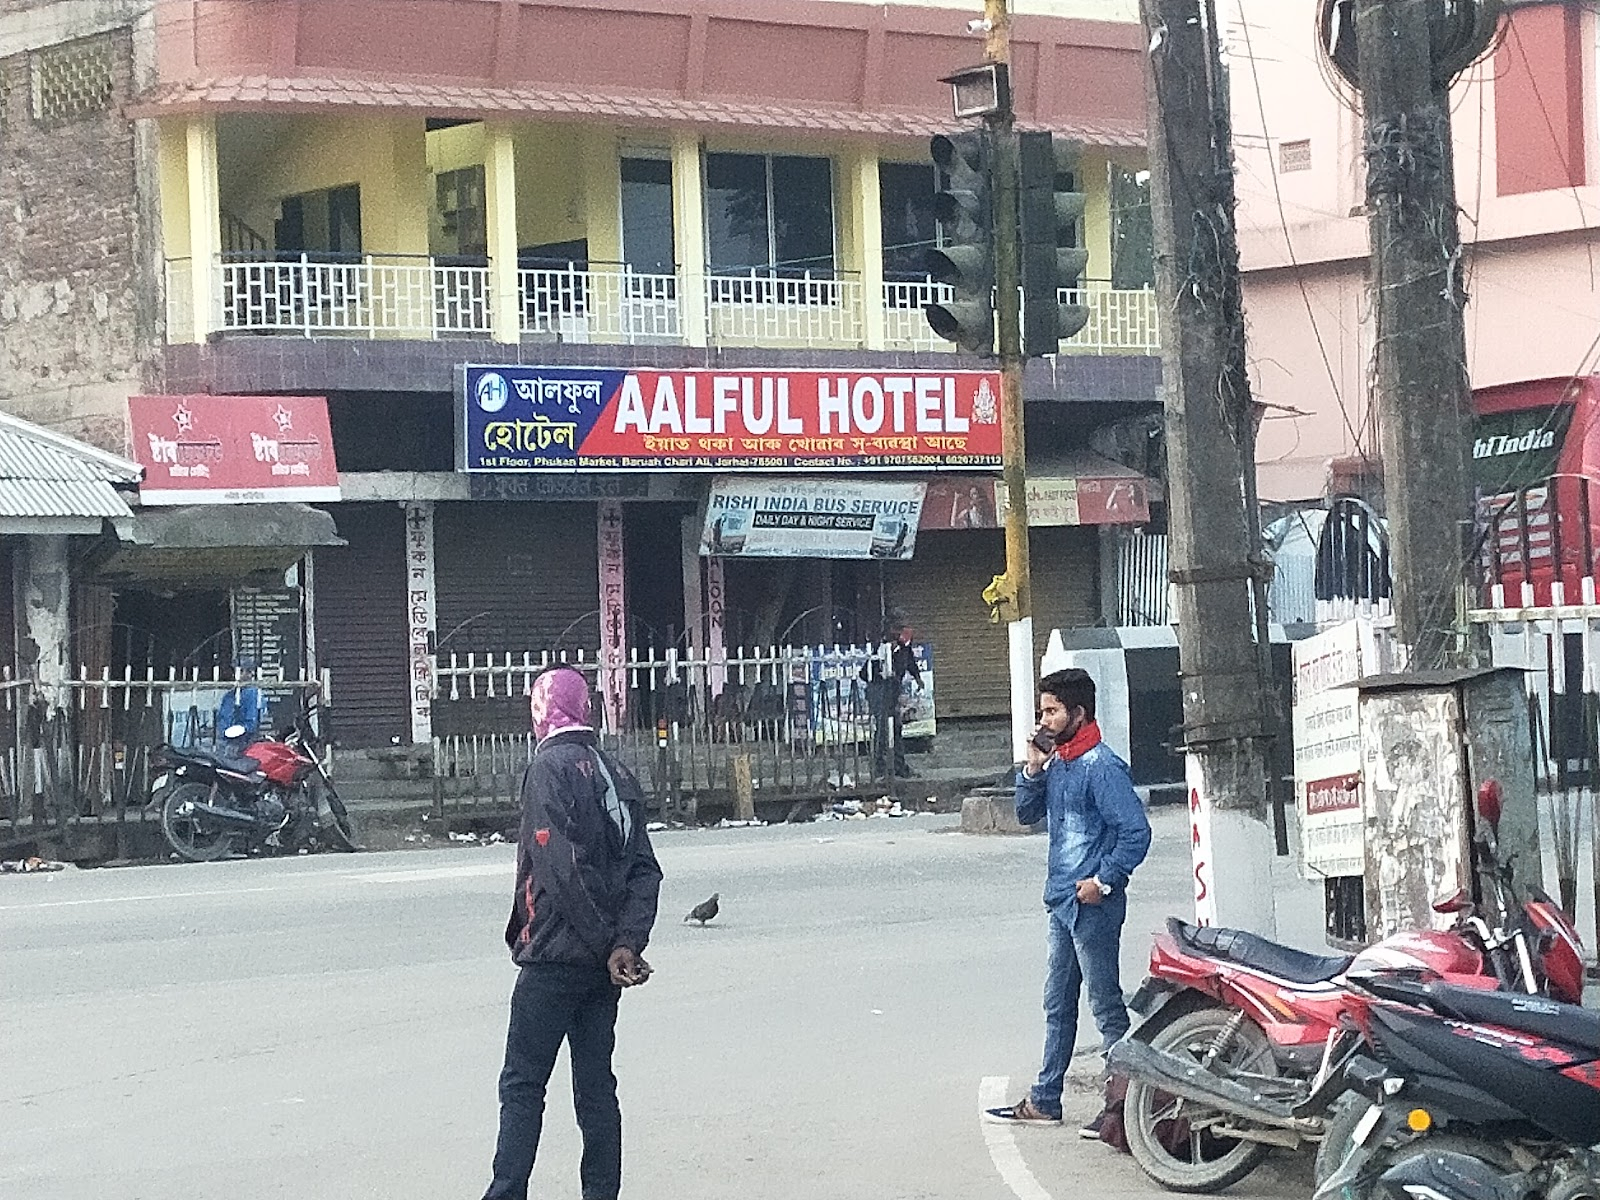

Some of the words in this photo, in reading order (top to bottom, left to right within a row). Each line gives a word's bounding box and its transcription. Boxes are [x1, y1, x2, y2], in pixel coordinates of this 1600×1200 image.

[512, 376, 602, 413] আলফুল
[613, 375, 803, 434] AALFUL
[818, 377, 969, 433] HOTEL
[484, 413, 577, 453] হোটেল
[923, 435, 968, 452] আছে
[1501, 429, 1555, 456] India
[480, 457, 496, 467] 1st
[499, 457, 532, 468] Floor,
[534, 457, 576, 467] Phukan
[578, 457, 619, 468] Market,
[622, 457, 662, 467] Baruah
[663, 457, 692, 467] Chari
[793, 457, 836, 467] Contact
[712, 495, 757, 510] RISHI
[763, 497, 808, 511] INDIA
[813, 498, 846, 512] BUS
[850, 501, 919, 515] SERVICE
[754, 514, 780, 526] DAILY
[781, 515, 799, 526] DAY
[808, 516, 834, 527] NIGHT
[834, 517, 872, 529] SERVICE
